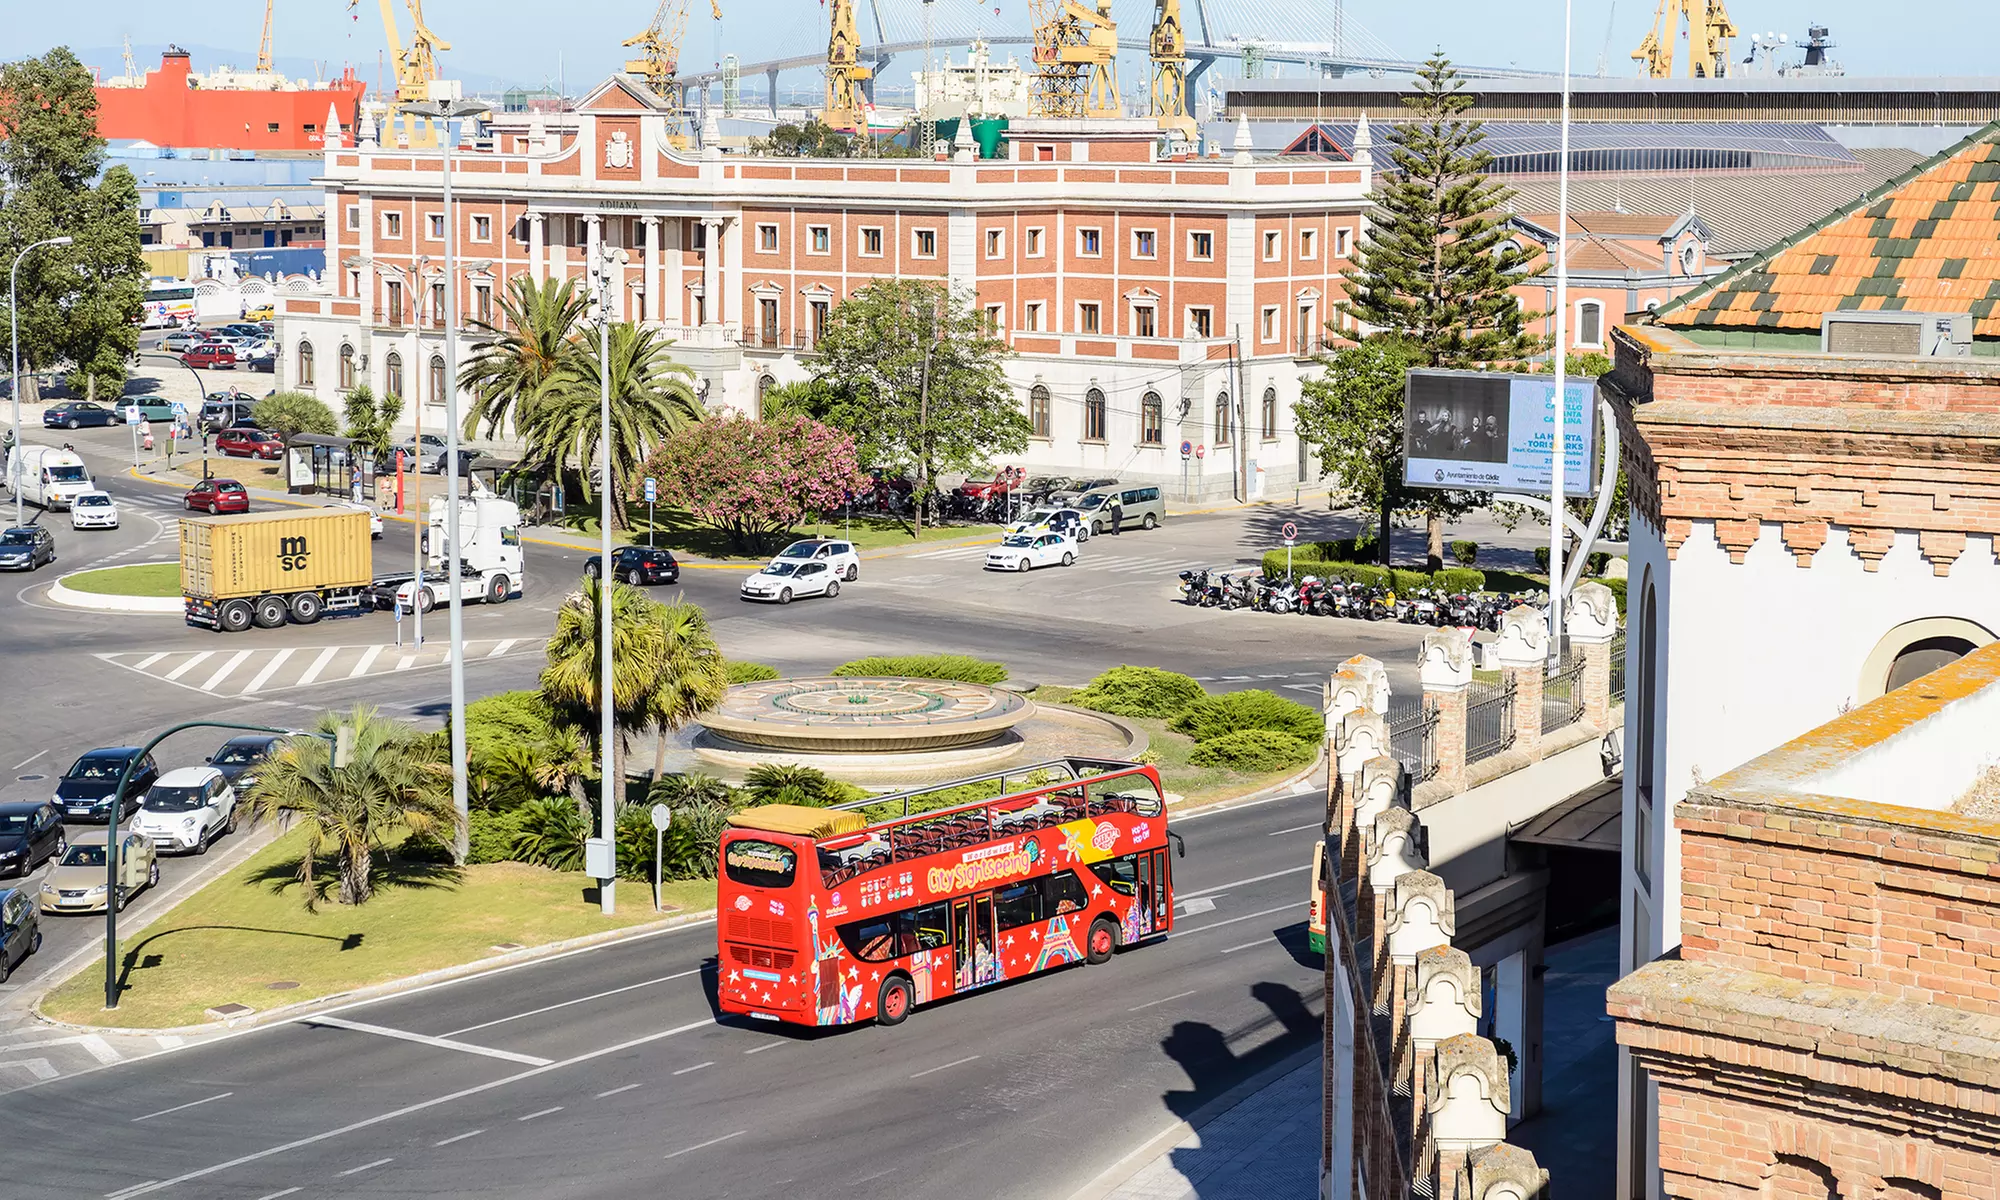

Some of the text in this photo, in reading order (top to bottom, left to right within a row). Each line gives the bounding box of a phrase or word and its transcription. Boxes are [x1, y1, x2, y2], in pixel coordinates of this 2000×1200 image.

[599, 200, 639, 210] ADUANA
[1545, 403, 1583, 411] CATILLO
[1534, 432, 1583, 442] LA HRTA
[1528, 440, 1584, 451] TORI SRKS
[966, 845, 1013, 861] Worldwide
